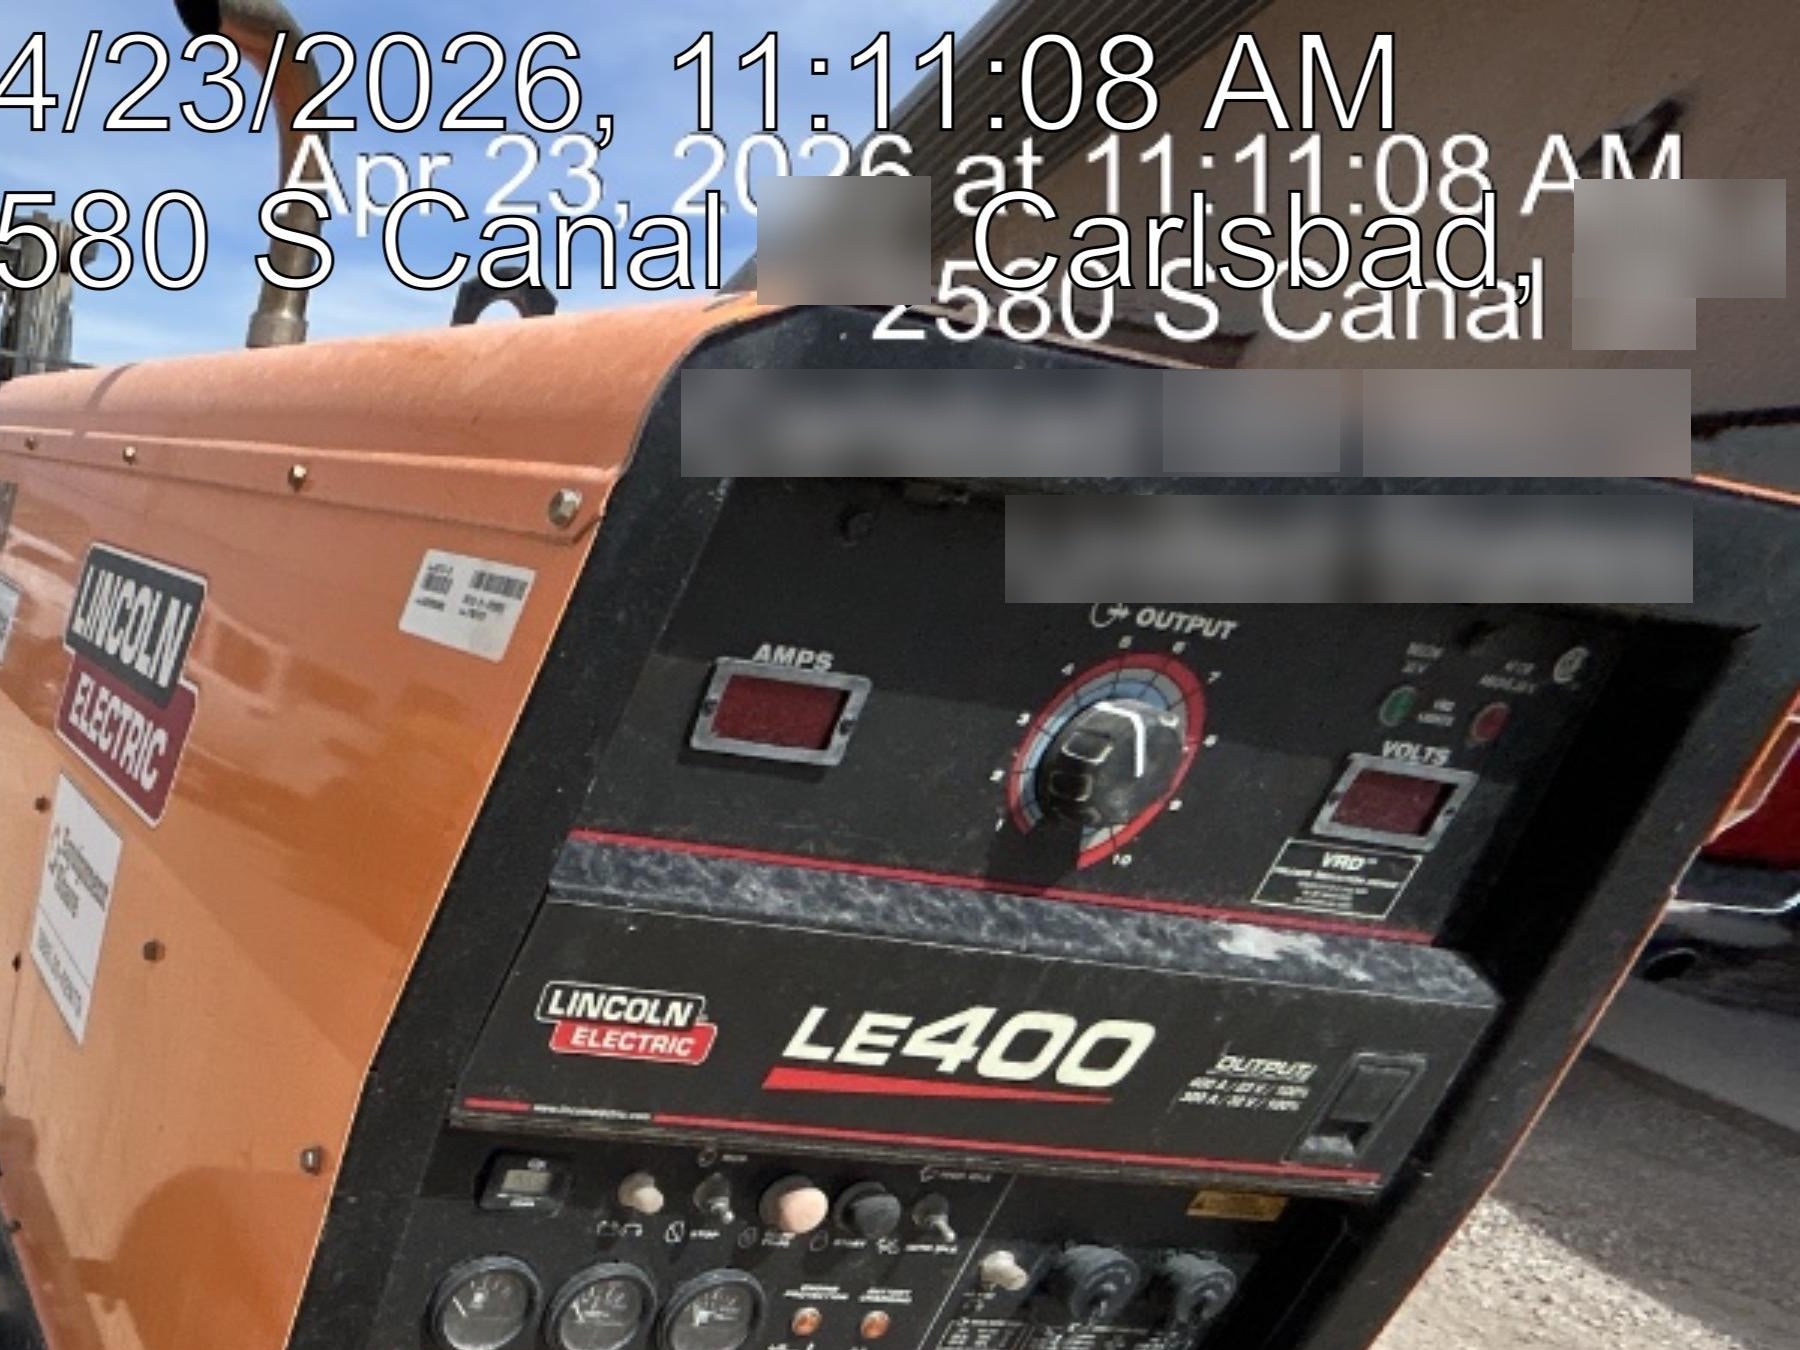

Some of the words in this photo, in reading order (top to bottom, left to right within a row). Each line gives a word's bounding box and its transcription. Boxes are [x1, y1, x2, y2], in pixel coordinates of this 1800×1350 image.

[71, 564, 194, 689] LINCOLN
[1135, 607, 1238, 641] OUTPUT
[751, 643, 835, 672] AMPS
[1060, 661, 1076, 677] 4
[68, 671, 169, 793] ELECTRIC
[1382, 740, 1452, 767] VOLTS
[547, 989, 694, 1027] LINCOLN
[570, 1026, 696, 1057] ELECTRIC
[781, 1005, 1158, 1087] LE400
[1214, 1055, 1316, 1083] OUTPUT
